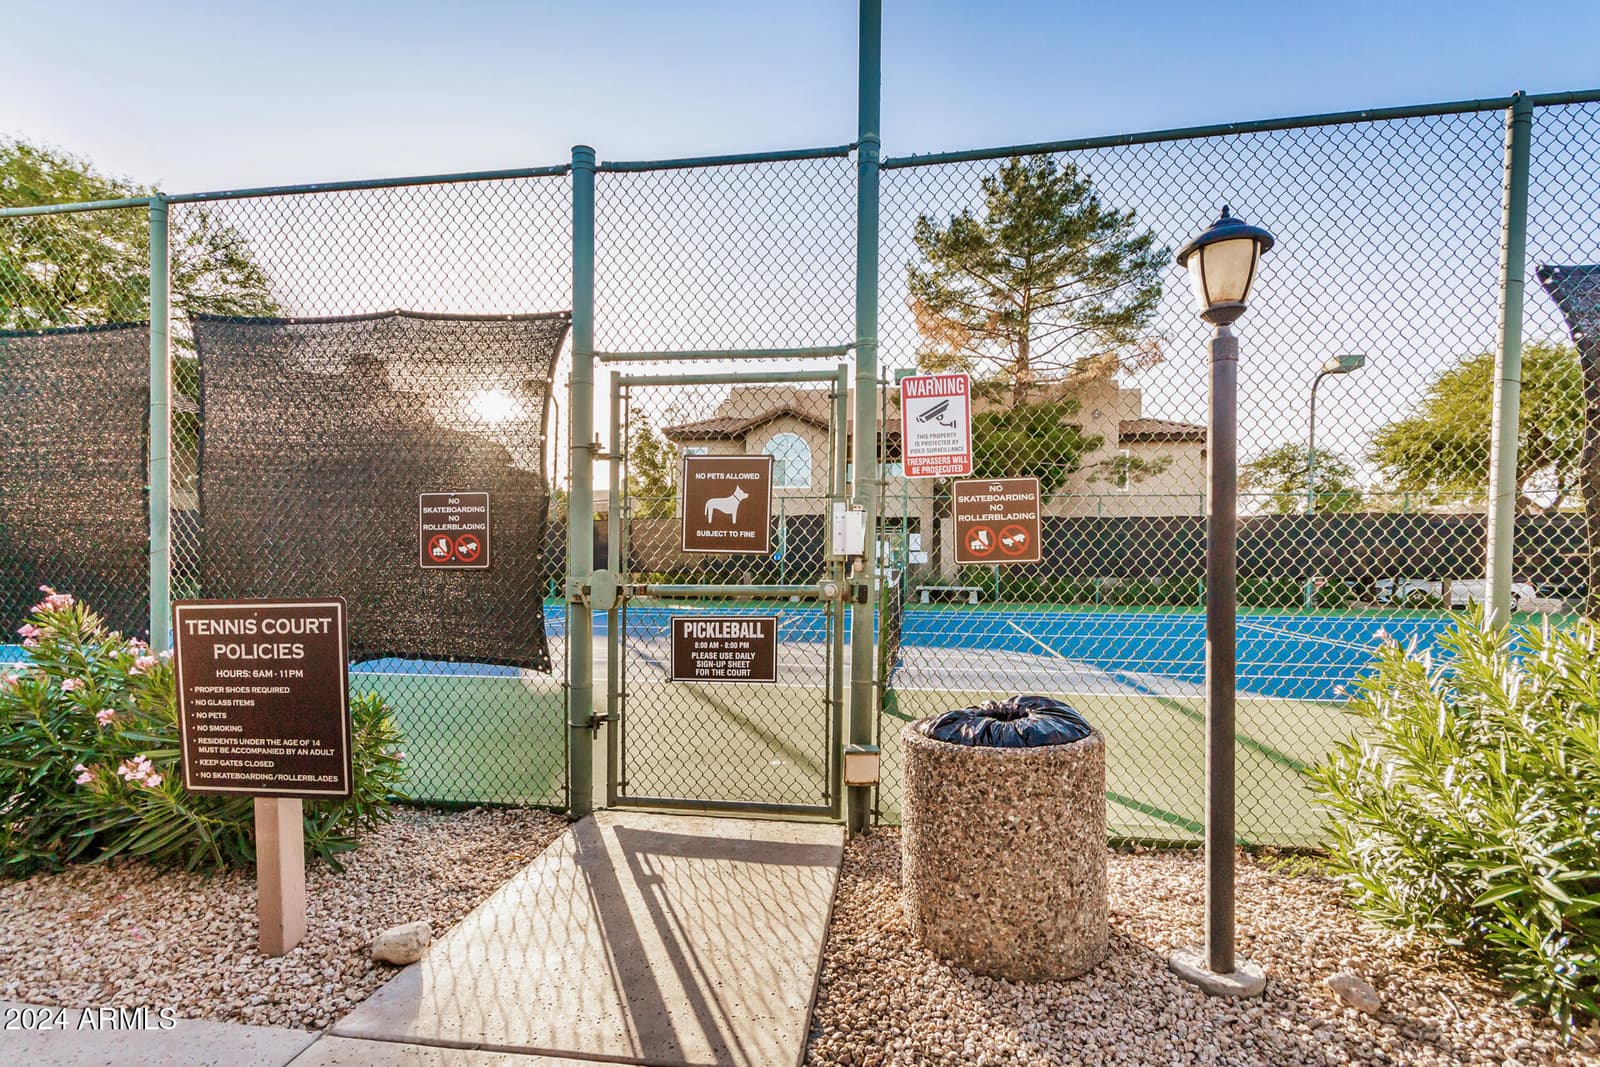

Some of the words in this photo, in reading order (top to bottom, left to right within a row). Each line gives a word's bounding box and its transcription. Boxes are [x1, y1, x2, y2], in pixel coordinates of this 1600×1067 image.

[906, 378, 964, 396] WARNING
[907, 457, 951, 465] TRESPASSERS
[922, 465, 963, 473] PROSECUTED
[958, 494, 1035, 502] SKATEBOARDING
[958, 513, 1036, 522] ROLLERBLADING
[185, 619, 257, 635] TENNIS
[262, 618, 332, 634] COURT
[684, 622, 764, 638] PICKLEBALL
[214, 644, 304, 659] POLICIES
[213, 772, 338, 782] SKATEBOARDING/ROLLERBLADES
